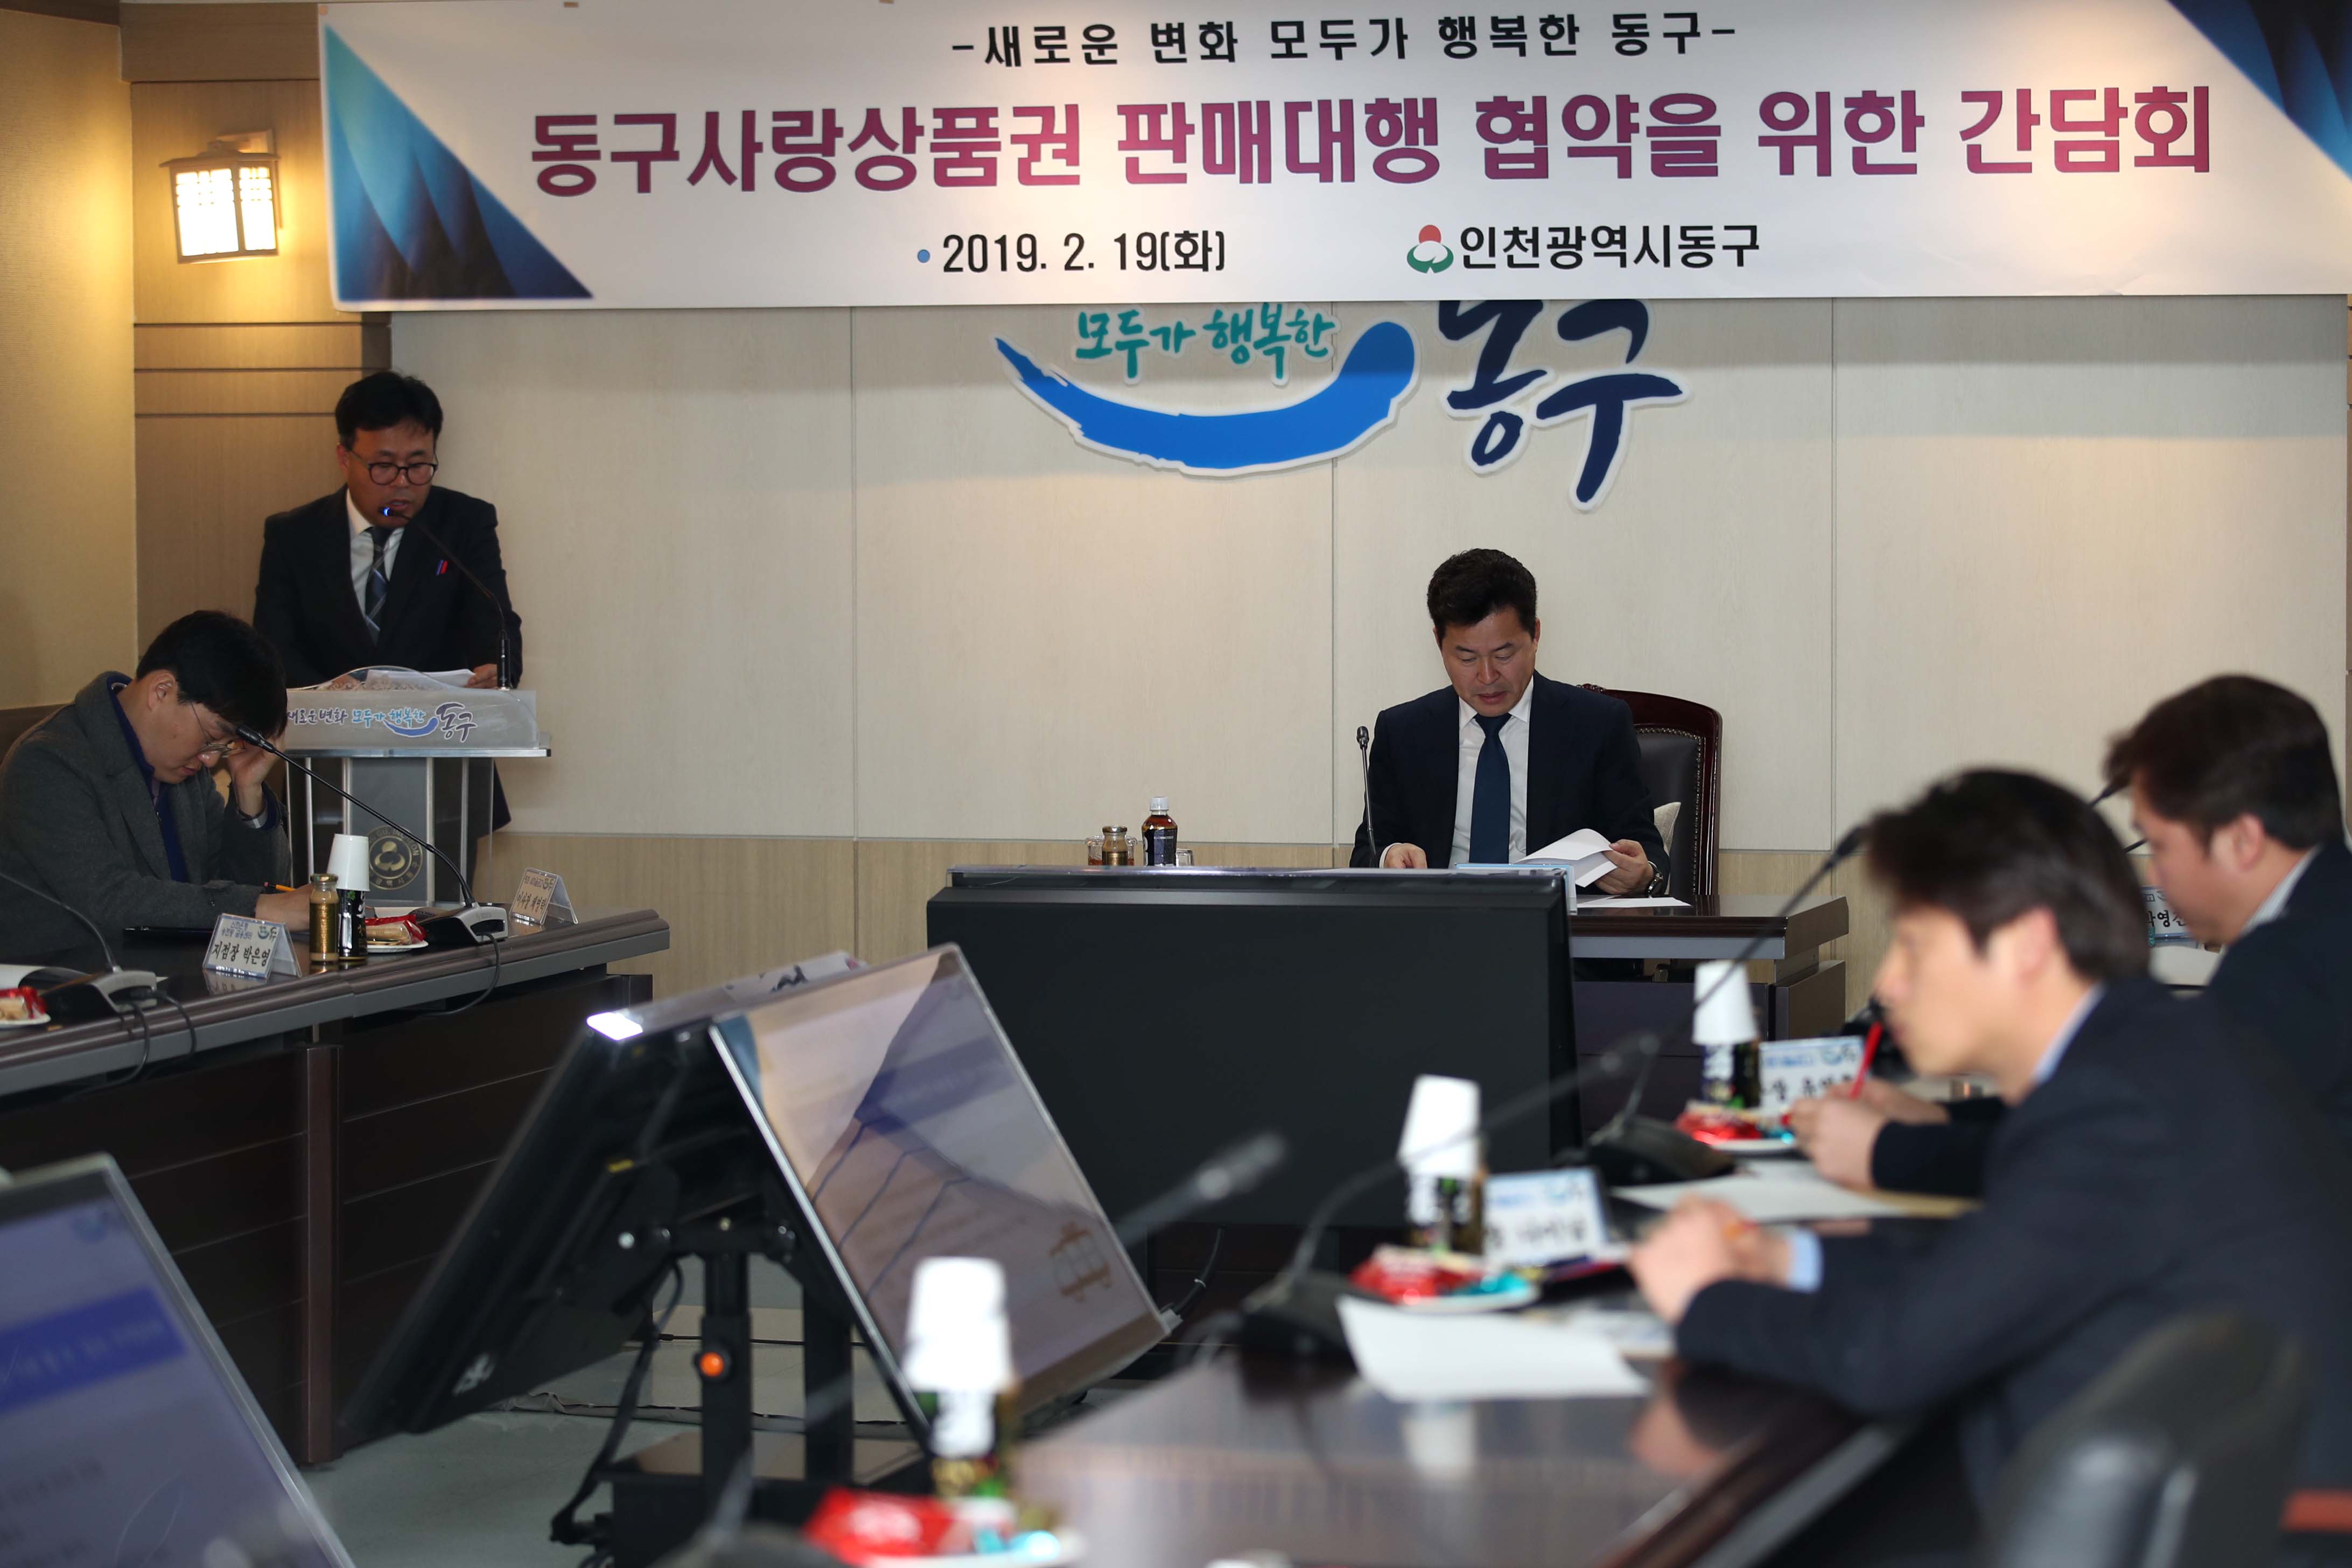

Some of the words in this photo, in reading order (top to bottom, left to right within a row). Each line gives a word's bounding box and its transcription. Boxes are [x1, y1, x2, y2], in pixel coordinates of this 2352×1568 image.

[951, 23, 1118, 67] -새로운
[1150, 20, 1238, 64] 변화
[1270, 17, 1409, 61] 모두가
[1438, 13, 1580, 60] 행복한
[1611, 12, 1735, 57] 동구-
[531, 103, 1079, 198] 동구사랑상품권
[1117, 97, 1440, 184] 판매대행
[1475, 92, 1722, 180] 협약을
[1758, 89, 1926, 177] 위한
[1959, 85, 2210, 174] 간담회
[943, 233, 1047, 273] 2019.
[1063, 233, 1094, 271] 2.
[1460, 225, 1760, 270] 인천광역시동구
[1076, 309, 1196, 379] 모두가
[1202, 302, 1335, 380] 행복한
[352, 709, 385, 727] 모두가
[389, 706, 426, 727] 행복한
[436, 702, 477, 743] 동구
[212, 941, 240, 962] 지점장
[243, 946, 271, 967] 박은영
